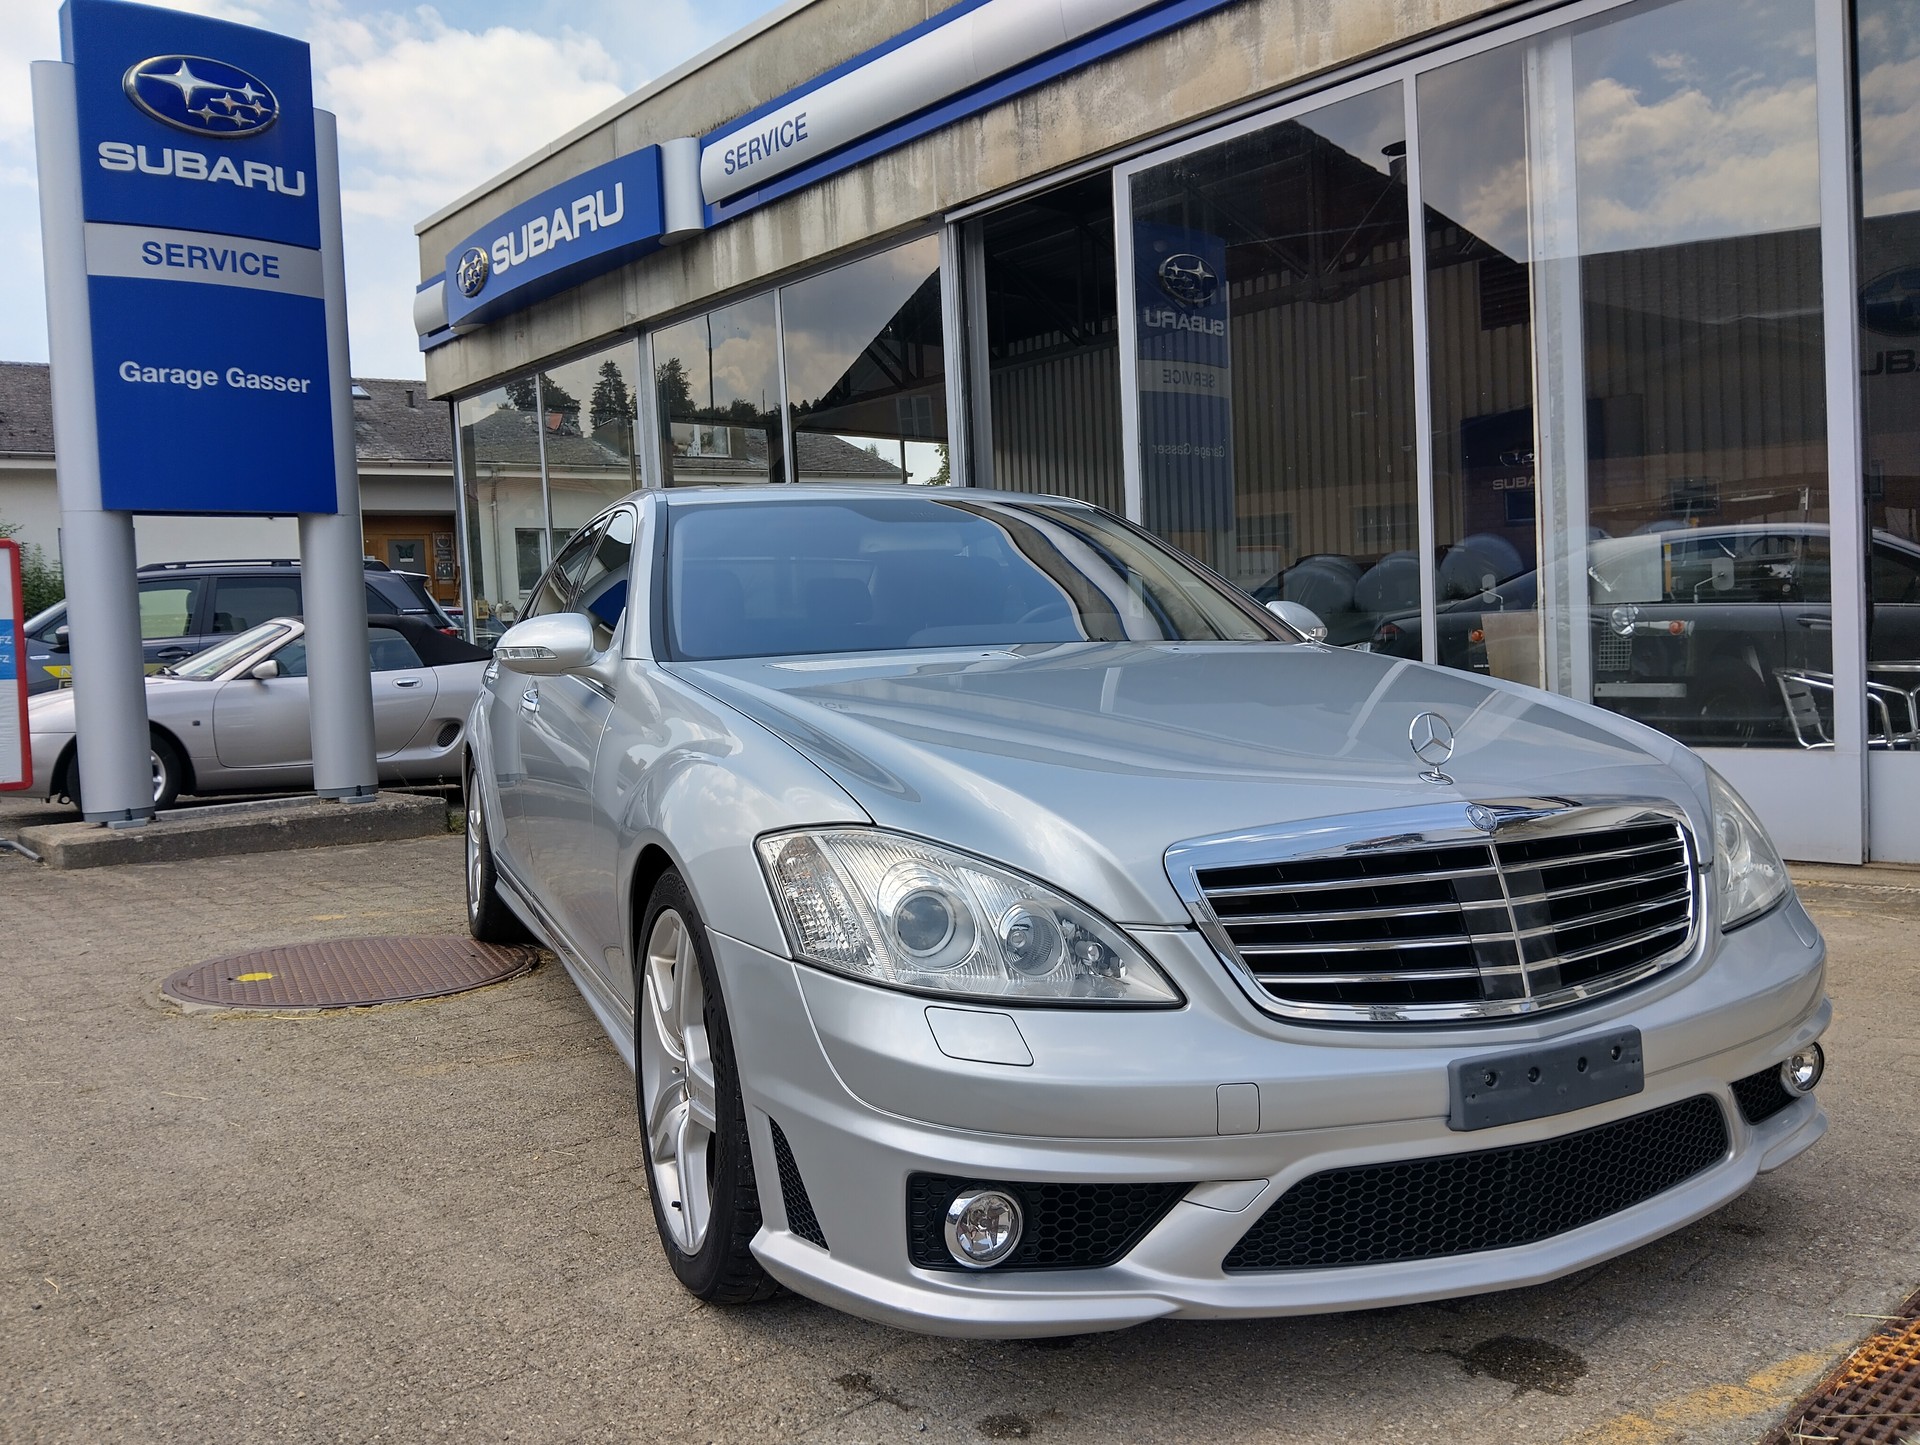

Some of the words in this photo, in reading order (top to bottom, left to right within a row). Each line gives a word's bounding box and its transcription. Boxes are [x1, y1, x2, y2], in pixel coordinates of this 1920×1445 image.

[98, 141, 306, 197] SUBARU
[724, 112, 808, 176] SERVICE
[491, 181, 625, 276] SUBARU
[142, 241, 280, 279] SERVICE
[119, 360, 219, 390] Garage
[226, 367, 310, 394] Gasser
